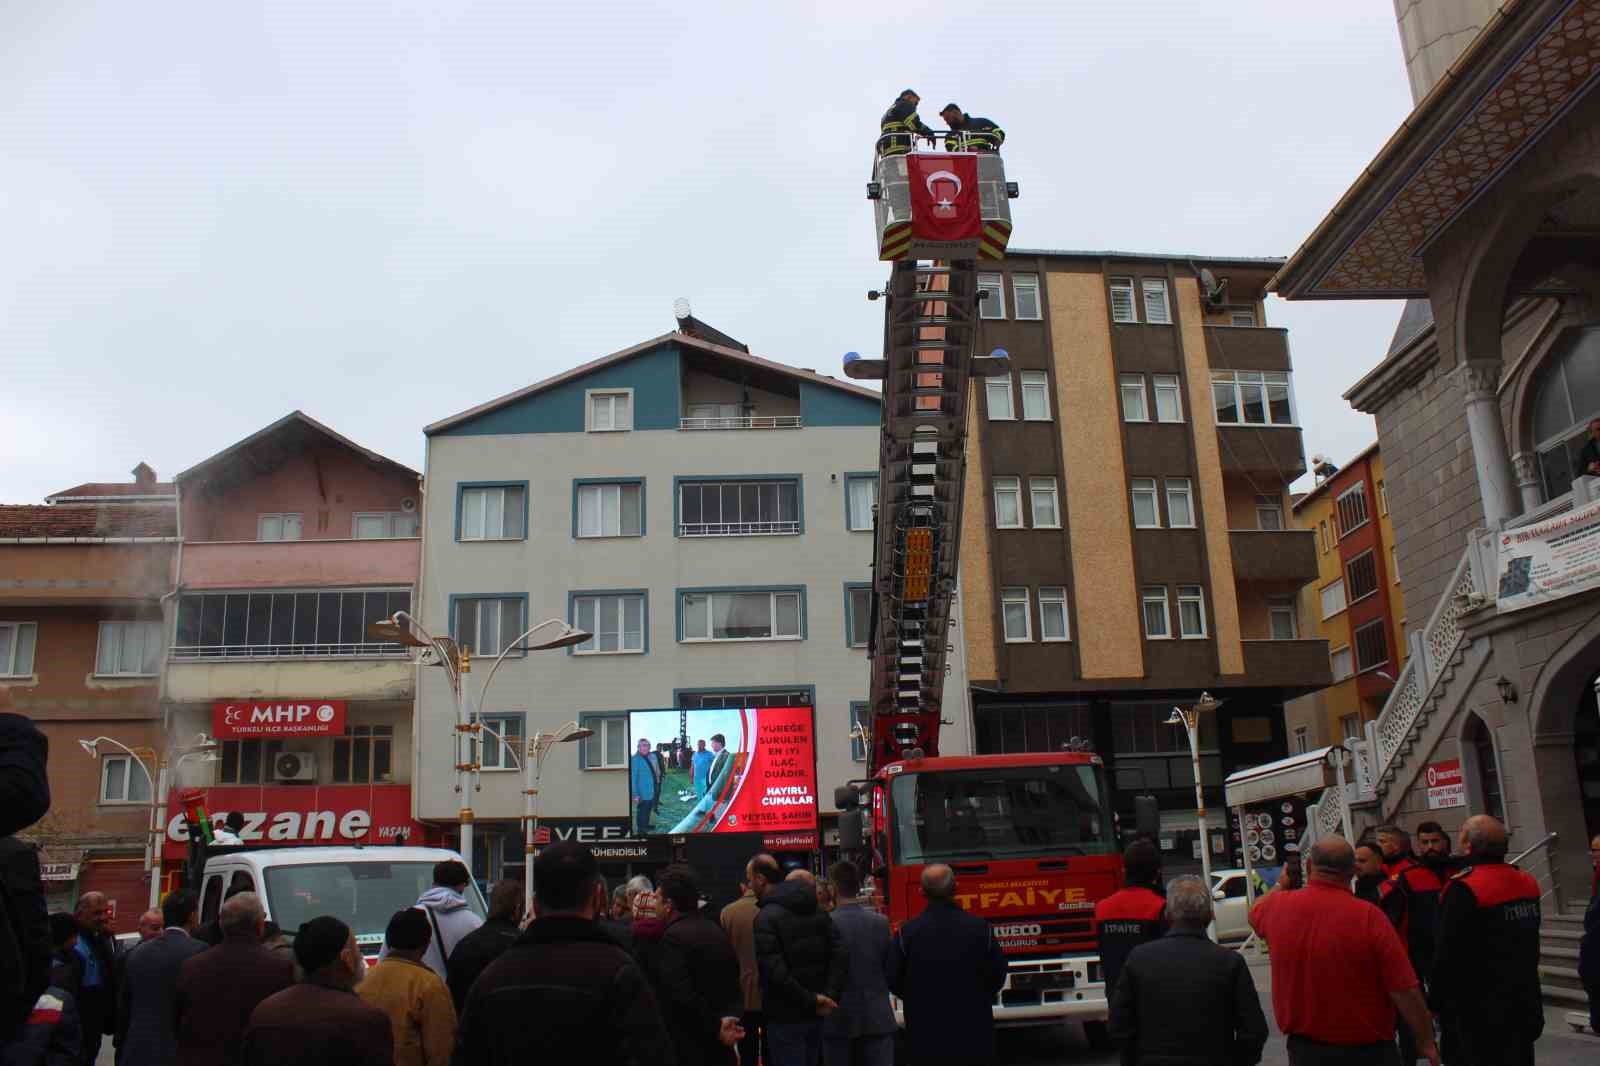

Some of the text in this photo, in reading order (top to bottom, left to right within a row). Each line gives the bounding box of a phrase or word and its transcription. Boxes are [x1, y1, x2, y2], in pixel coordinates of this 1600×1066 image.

[250, 704, 311, 723] MHP
[767, 786, 808, 796] HAYIRLI
[761, 795, 814, 806] CUMALAR
[167, 808, 371, 841] ezane
[590, 847, 648, 857] ÜHENDİSLİK
[994, 924, 1041, 937] IVECO
